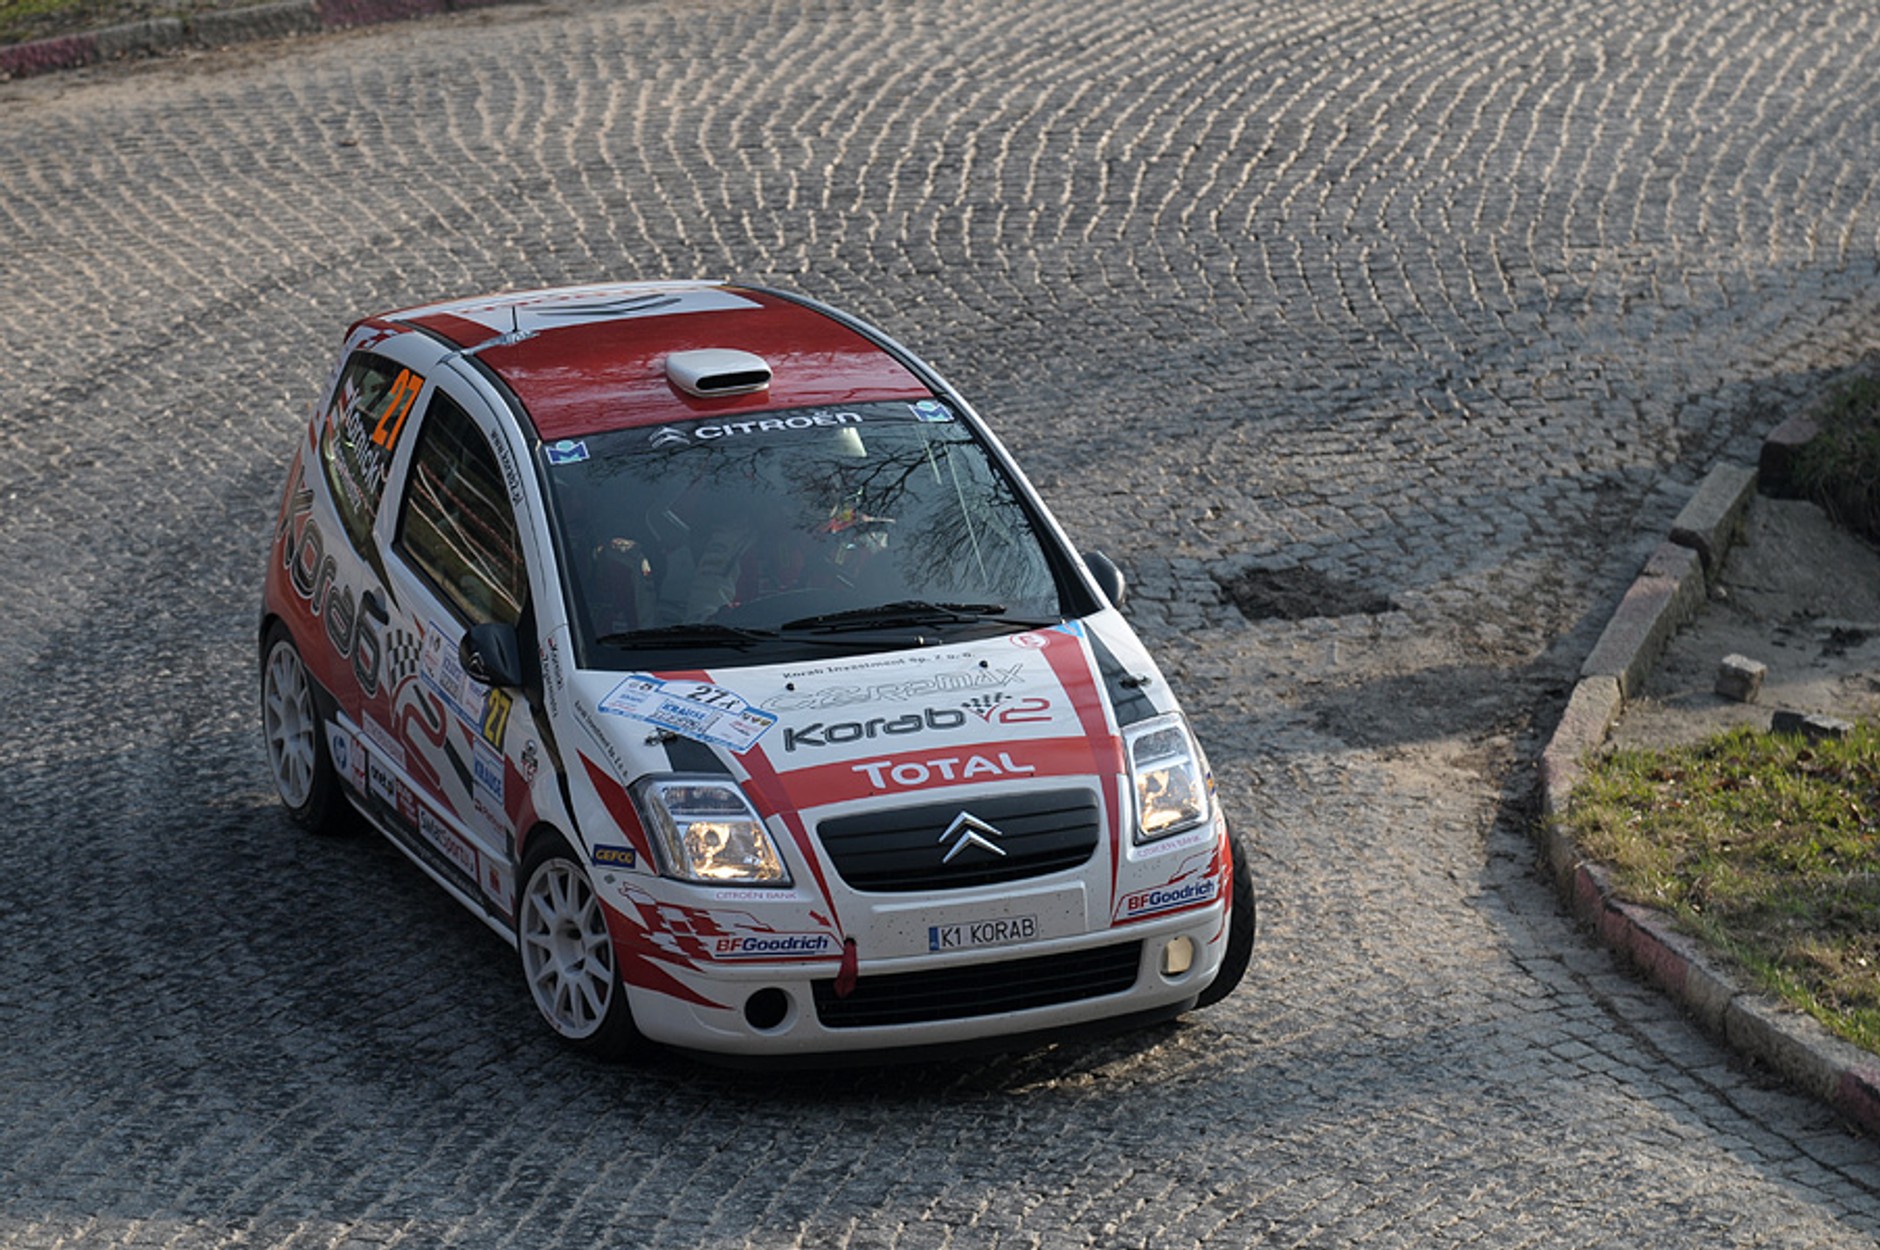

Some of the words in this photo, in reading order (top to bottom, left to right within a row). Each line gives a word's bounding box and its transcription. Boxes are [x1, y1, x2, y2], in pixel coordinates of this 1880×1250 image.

[372, 369, 424, 450] 27
[695, 411, 864, 439] CITROËN
[276, 463, 380, 698] Korab
[782, 667, 824, 680] Korab
[827, 658, 905, 673] Investment
[687, 685, 729, 704] 27
[484, 687, 512, 750] 27
[782, 706, 967, 752] Korab
[851, 752, 1036, 789] TOTAL
[595, 848, 634, 866] GEFCO
[1127, 880, 1216, 911] BFGoodrich
[715, 935, 829, 952] BFGoodrich
[940, 928, 962, 948] K1
[970, 918, 1036, 944] KORAB
